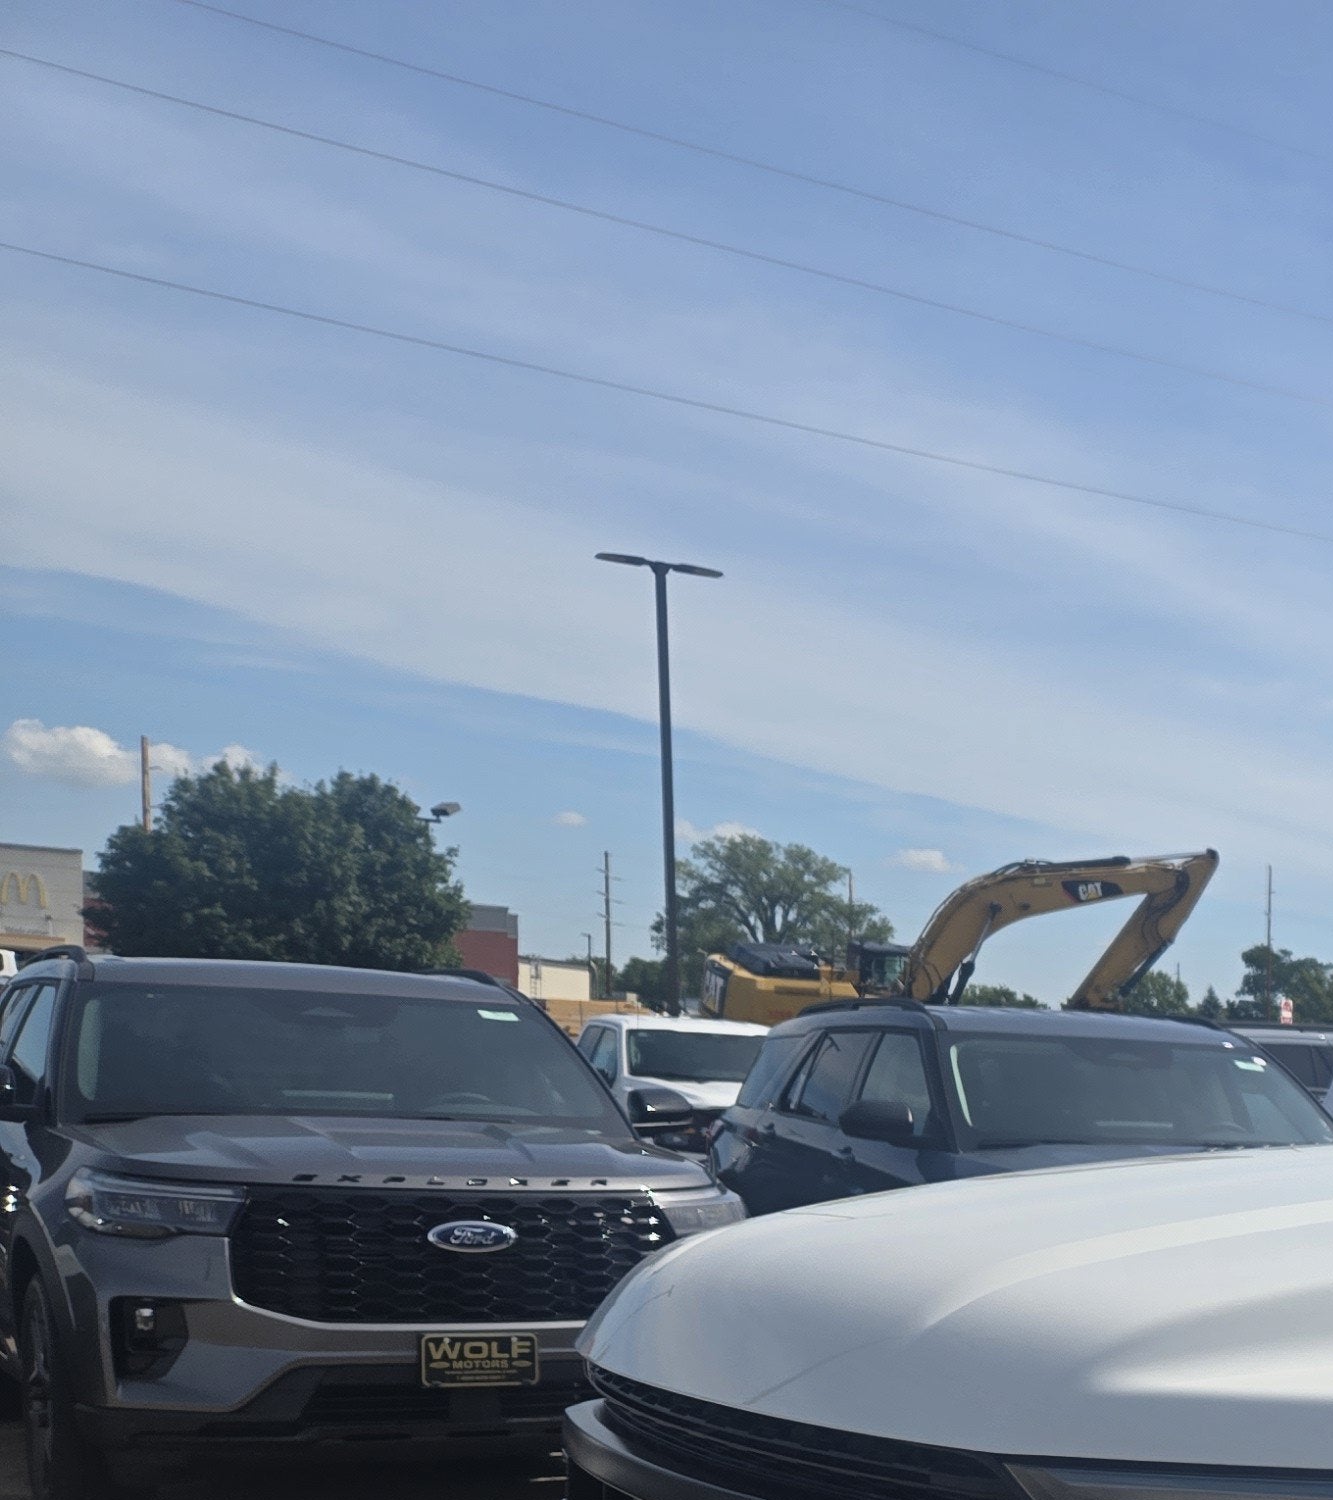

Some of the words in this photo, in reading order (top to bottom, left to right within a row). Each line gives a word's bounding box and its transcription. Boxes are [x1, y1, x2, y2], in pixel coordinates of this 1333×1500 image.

[1078, 881, 1103, 901] CAT
[292, 1173, 608, 1186] EXPLORER
[450, 1226, 499, 1245] Ford
[428, 1340, 532, 1360] WOLF
[452, 1360, 509, 1369] MOTORS
